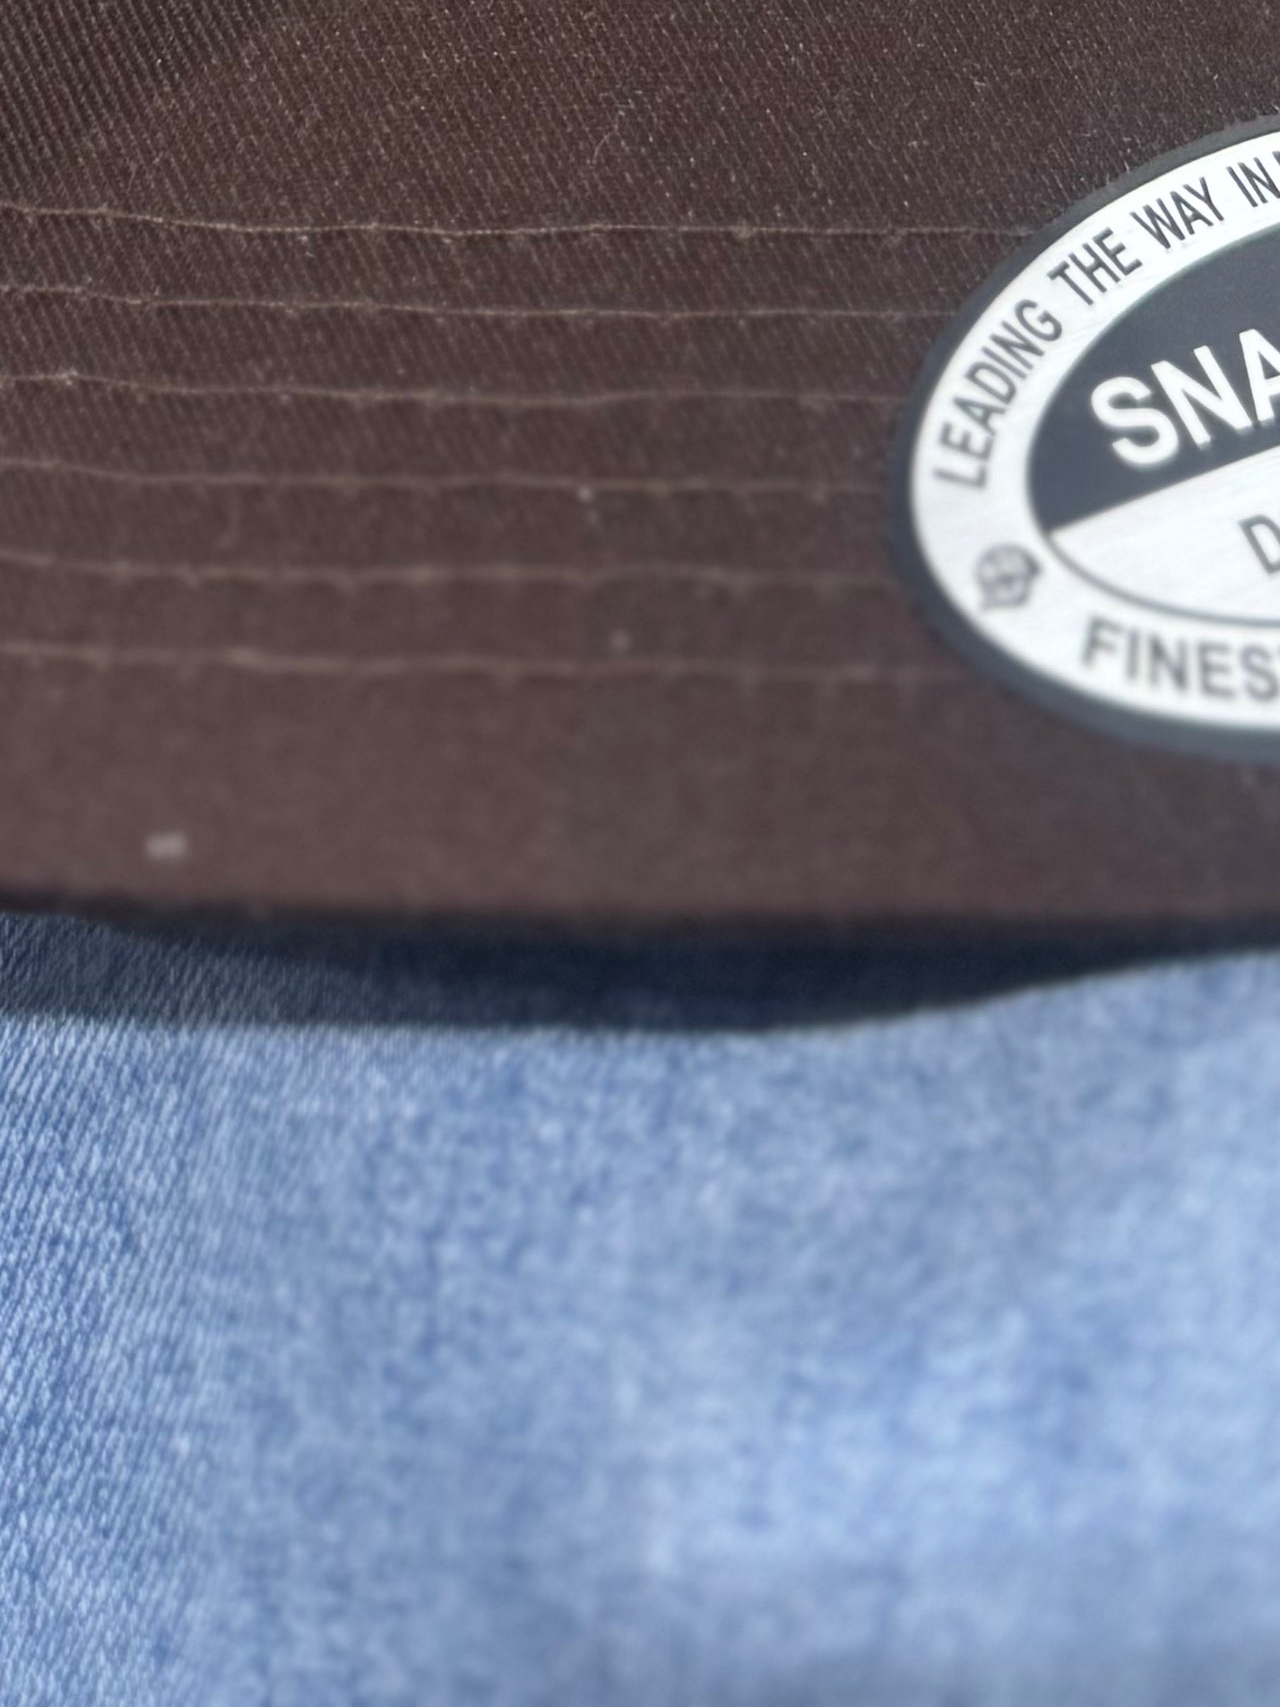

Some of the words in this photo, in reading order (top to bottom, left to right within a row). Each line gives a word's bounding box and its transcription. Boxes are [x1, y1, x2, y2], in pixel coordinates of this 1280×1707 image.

[932, 299, 1063, 489] LEADING
[1048, 228, 1142, 307] THE
[1131, 176, 1226, 250] WAY
